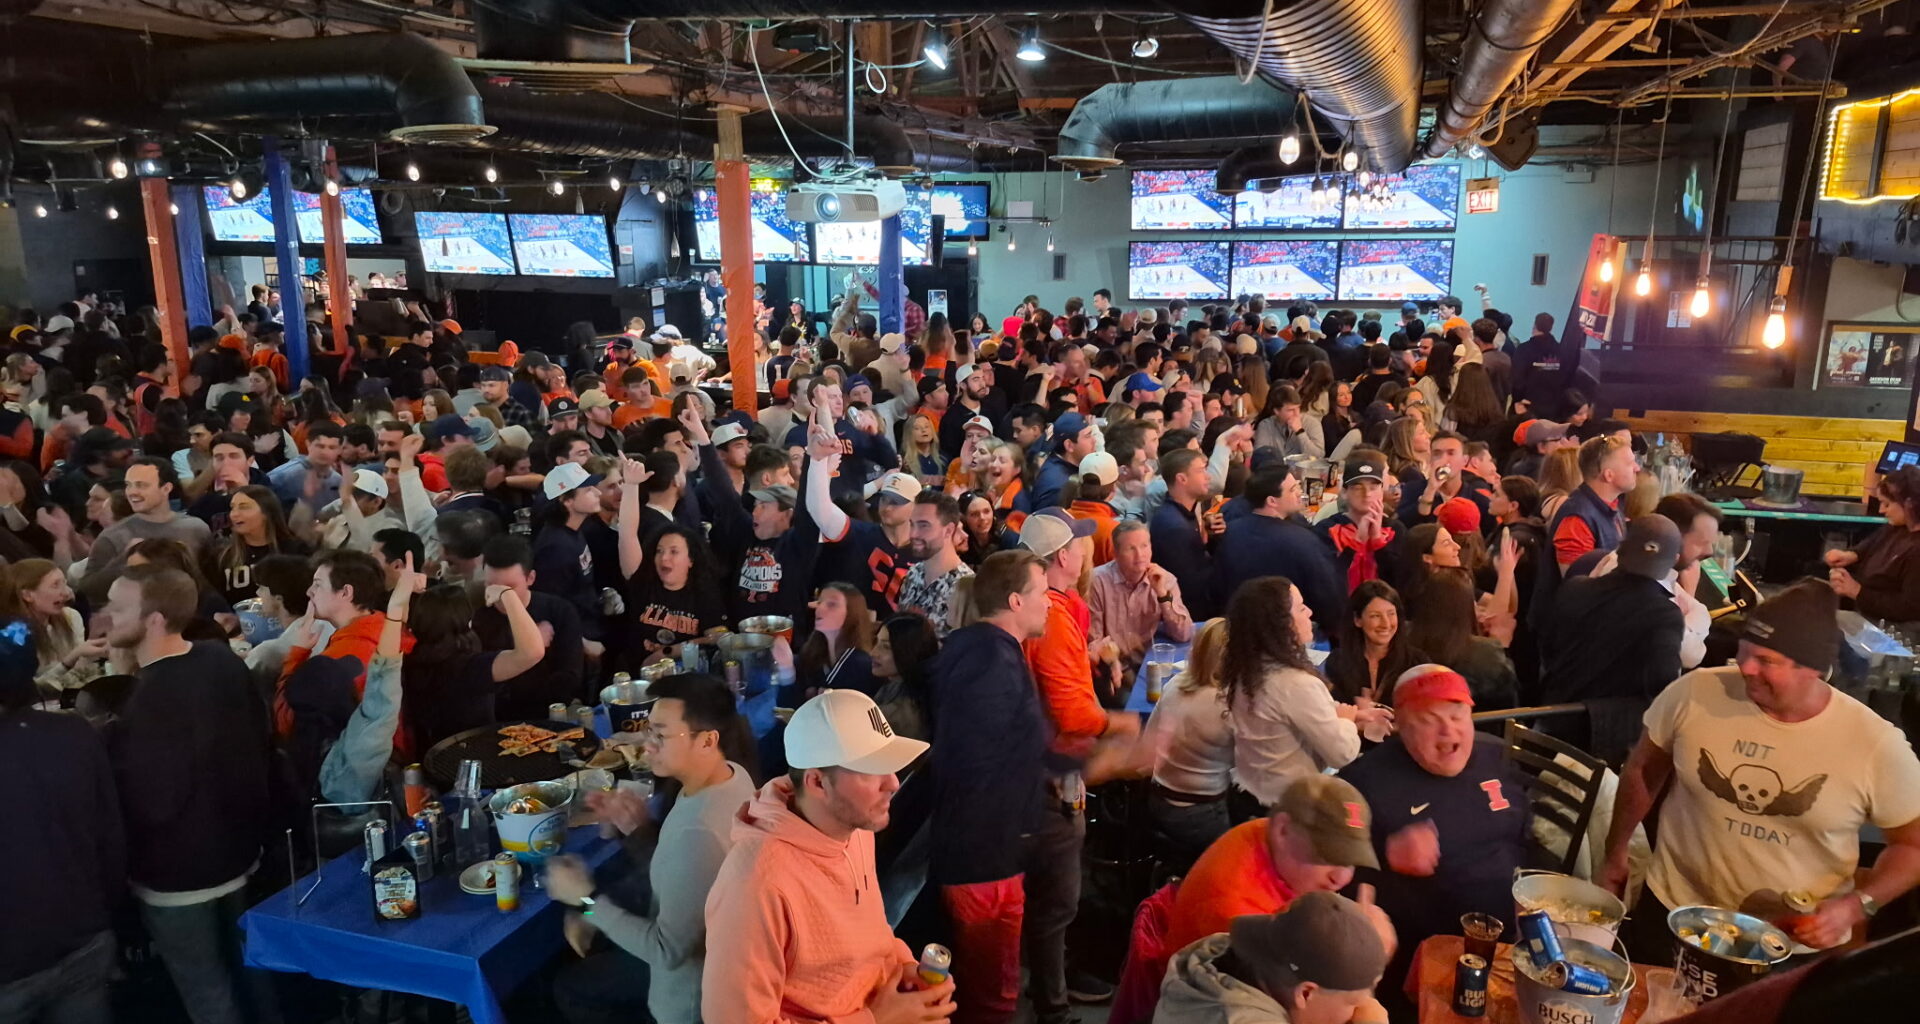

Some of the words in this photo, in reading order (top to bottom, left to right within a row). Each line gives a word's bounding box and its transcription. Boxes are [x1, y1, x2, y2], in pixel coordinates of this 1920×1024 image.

[1469, 191, 1495, 208] EXIT
[1732, 739, 1776, 760] NOT
[1480, 778, 1510, 812] I
[1344, 802, 1366, 829] I
[1724, 816, 1796, 846] TODAY
[1459, 994, 1485, 1008] LIGH
[1538, 1002, 1594, 1024] BUSCH
